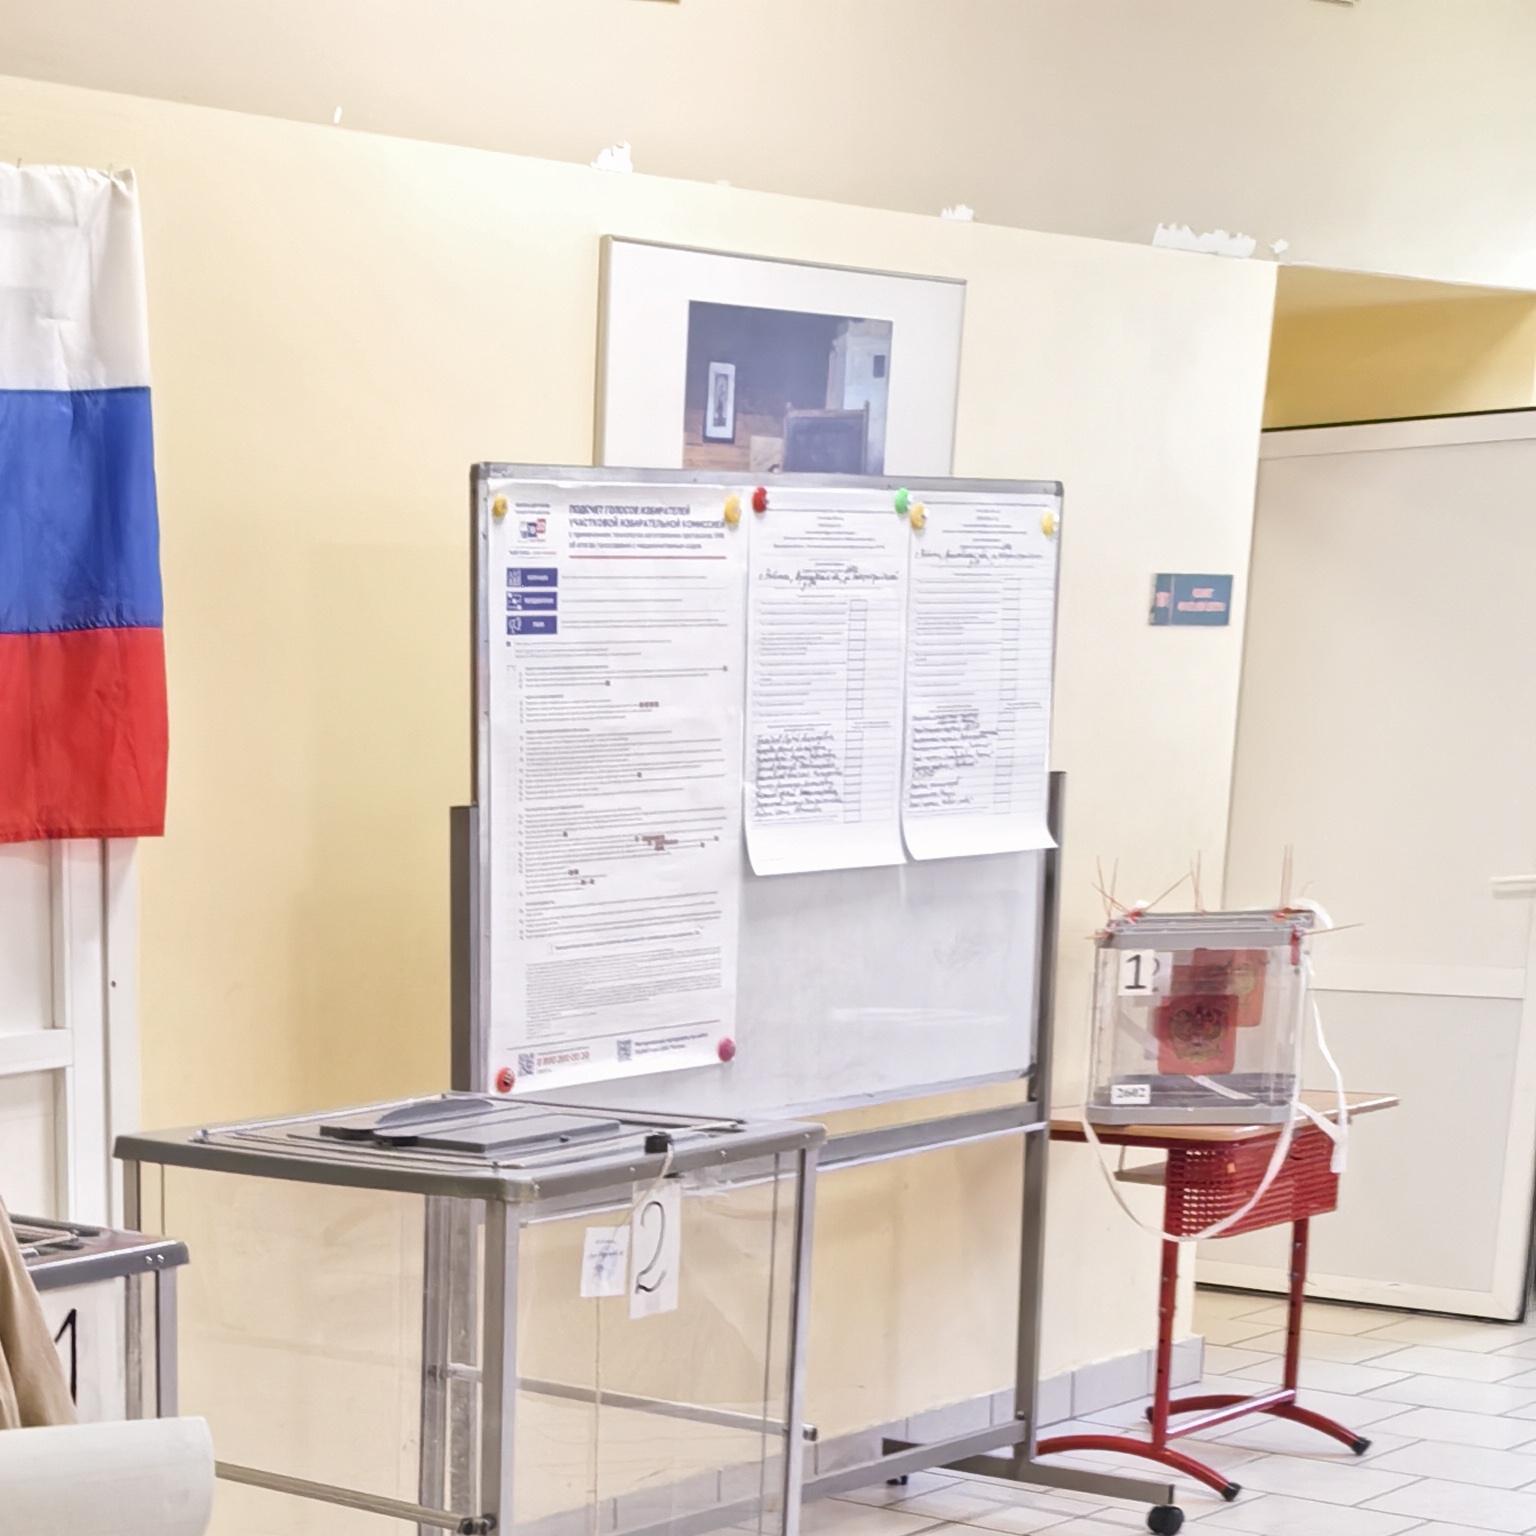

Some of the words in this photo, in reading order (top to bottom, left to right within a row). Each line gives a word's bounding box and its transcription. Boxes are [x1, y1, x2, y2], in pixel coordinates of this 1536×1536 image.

[569, 516, 619, 528] УЧАСТКОВОЙ
[620, 517, 680, 529] ИЗБИРАТЕЛЬНОЙ
[640, 504, 691, 516] ИЗБИРАТЕЛЕЙ
[1125, 954, 1147, 990] 1
[635, 1201, 668, 1295] 2
[54, 1307, 77, 1408] 1
